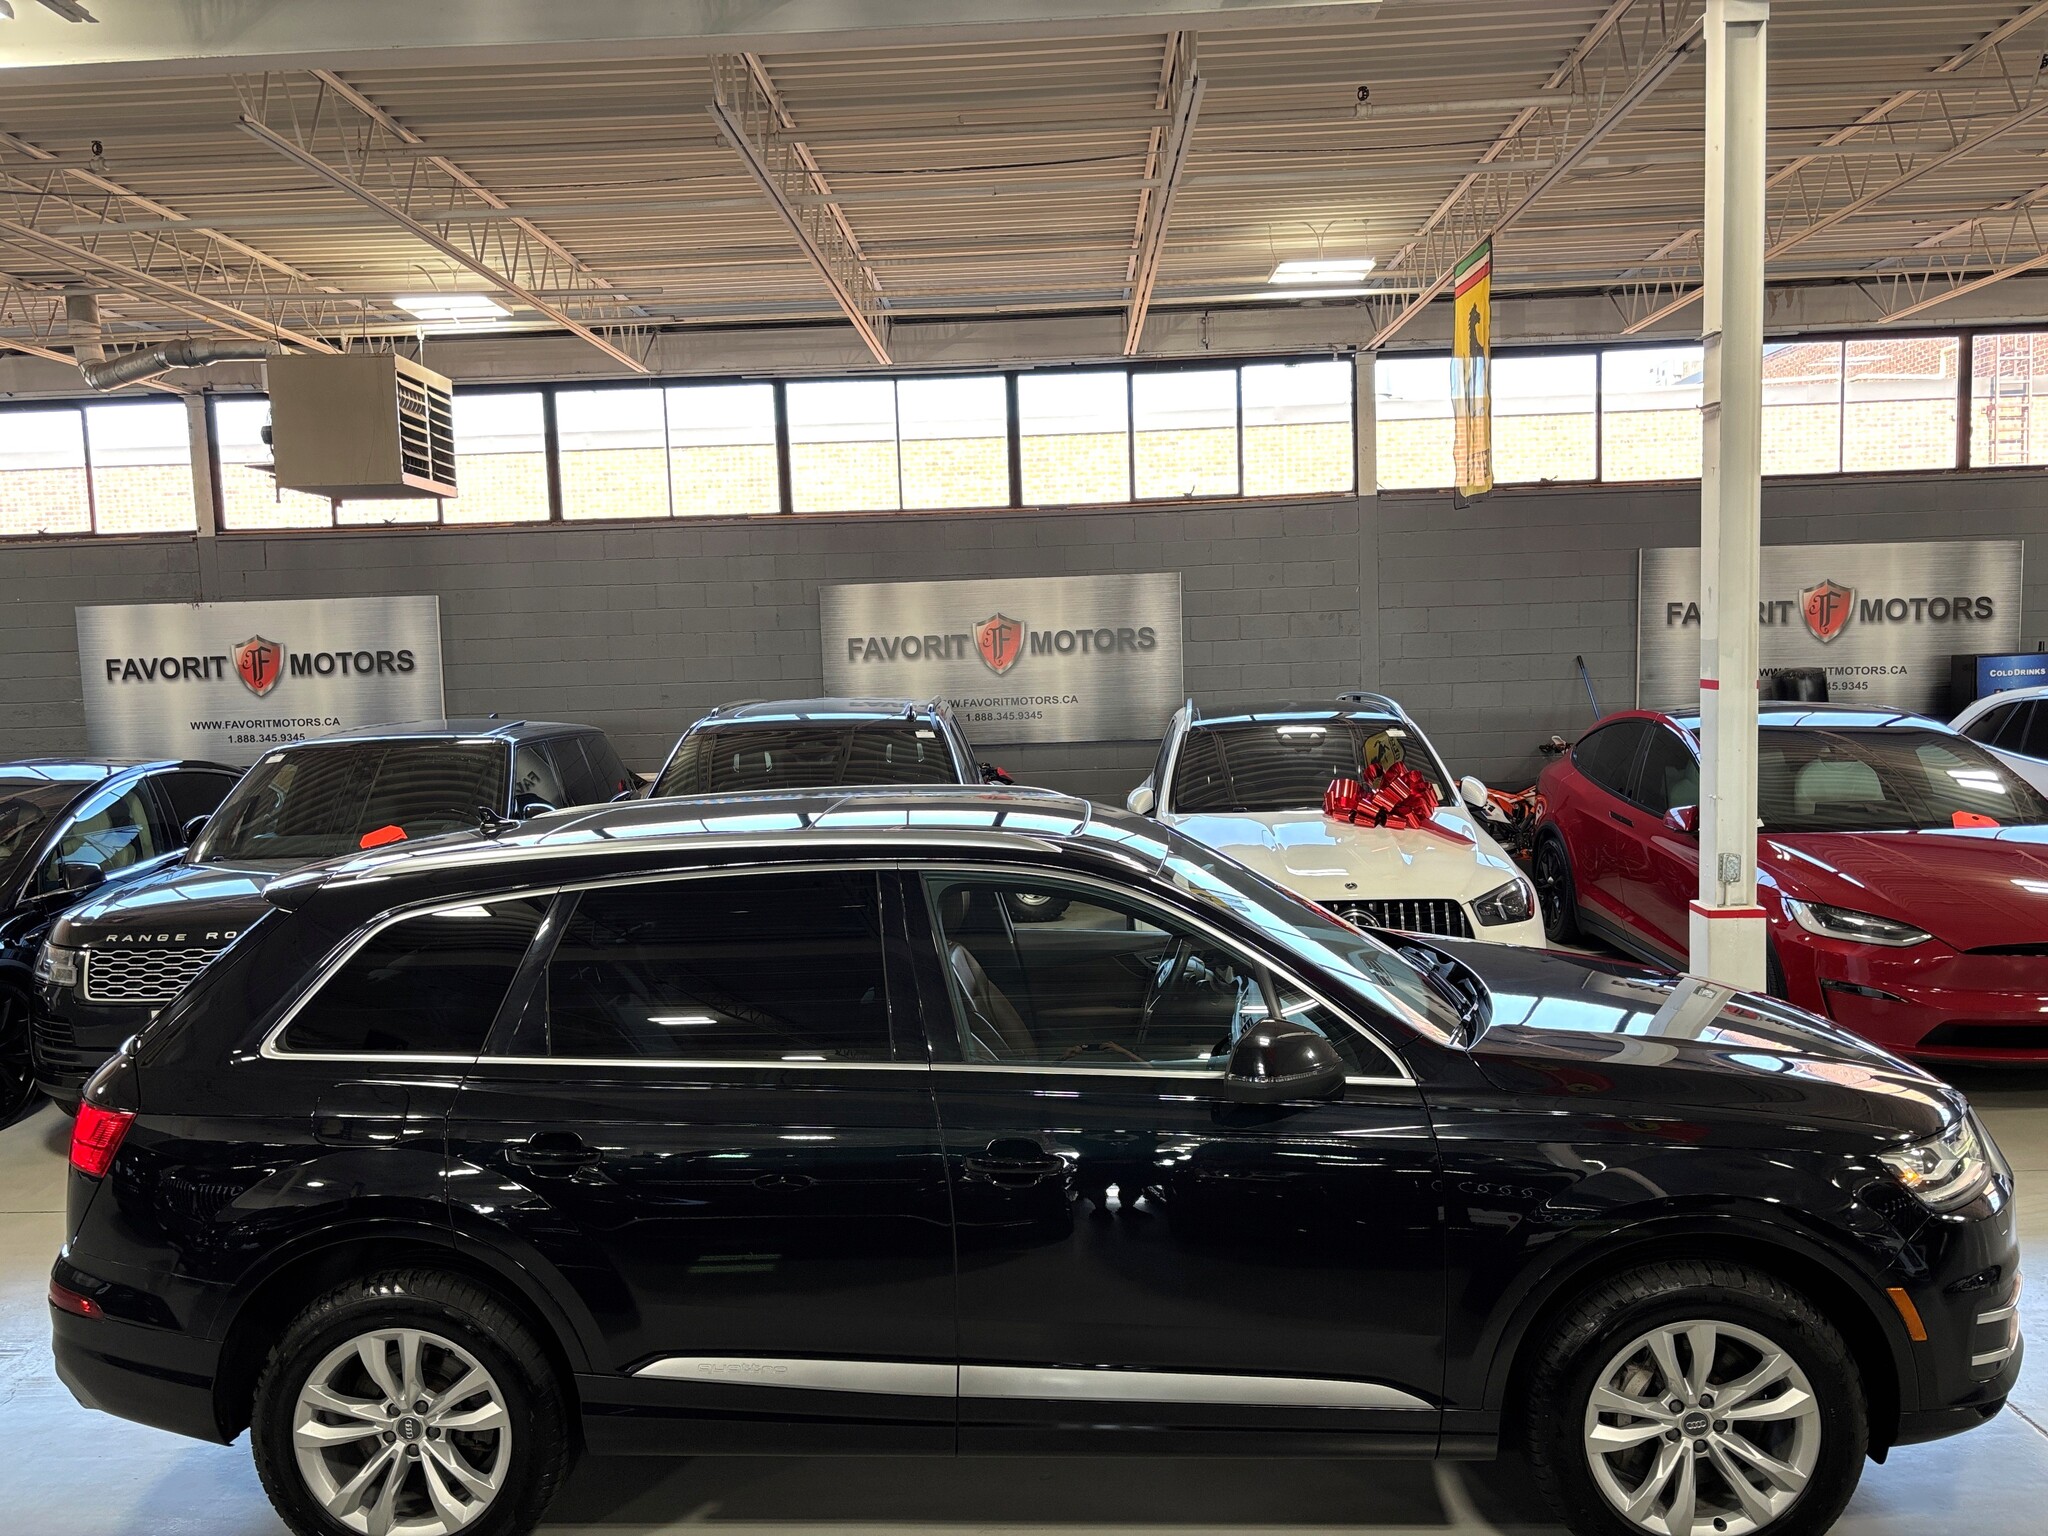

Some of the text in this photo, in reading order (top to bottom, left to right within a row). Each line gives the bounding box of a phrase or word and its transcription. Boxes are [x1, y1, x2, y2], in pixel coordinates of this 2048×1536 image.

[1859, 596, 1994, 622] MOTORS
[847, 633, 968, 662] FAVORIT
[1030, 626, 1156, 655] MOTORS
[106, 655, 227, 681] FAVORIT
[290, 649, 415, 676] MOTORS
[965, 711, 1043, 722] 1.888.345.9345
[190, 717, 341, 730] WWW.FAVORITMOTORS.CA
[228, 733, 306, 744] 1.888.345.9345
[106, 933, 188, 942] RANGE
